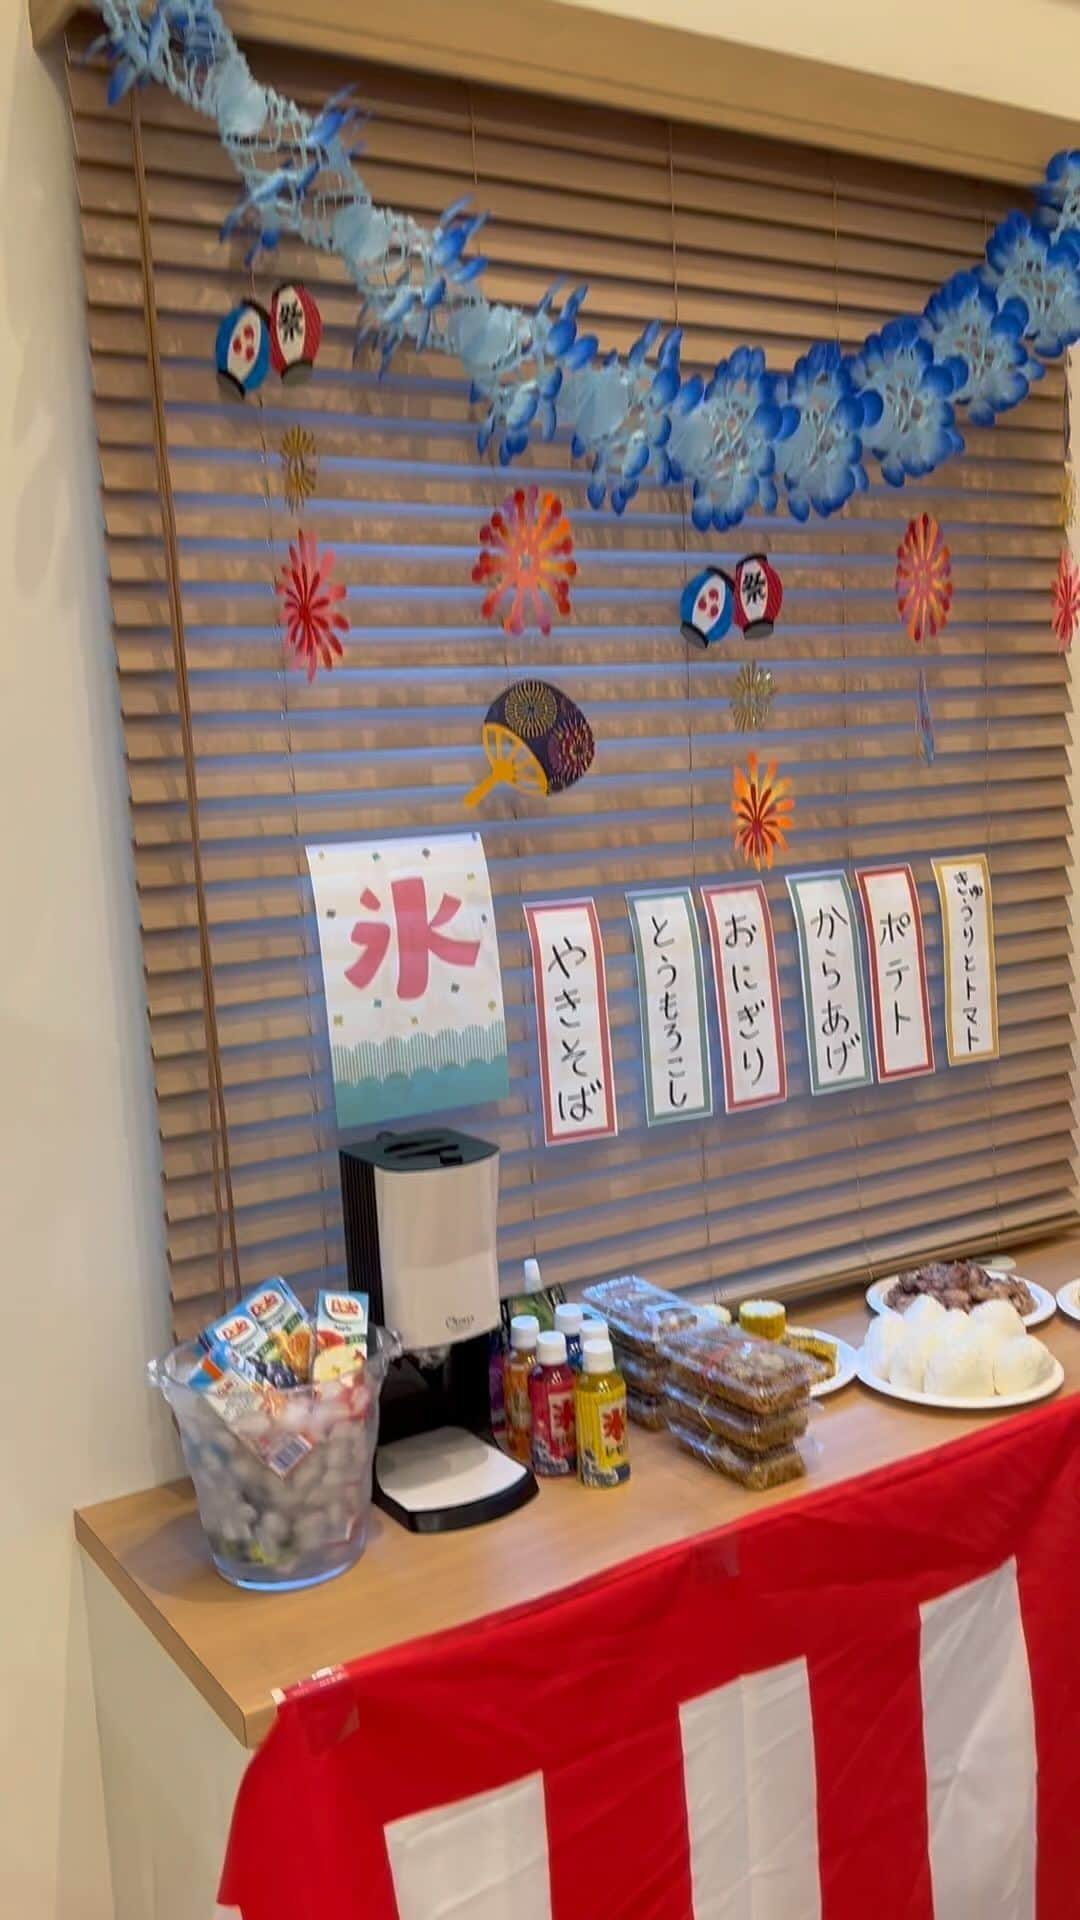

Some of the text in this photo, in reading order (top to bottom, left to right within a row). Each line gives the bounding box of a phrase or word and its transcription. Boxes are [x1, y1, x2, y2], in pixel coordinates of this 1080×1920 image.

[343, 876, 481, 1001] 氷
[724, 914, 766, 1086] おにぎり
[810, 905, 861, 1076] からあげ
[879, 911, 912, 1036] ポテト
[548, 936, 602, 1122] やきそば
[651, 915, 687, 1108] とうもろこし
[222, 1318, 250, 1342] Dole
[250, 1293, 279, 1317] Dole
[331, 1298, 359, 1314] Dole
